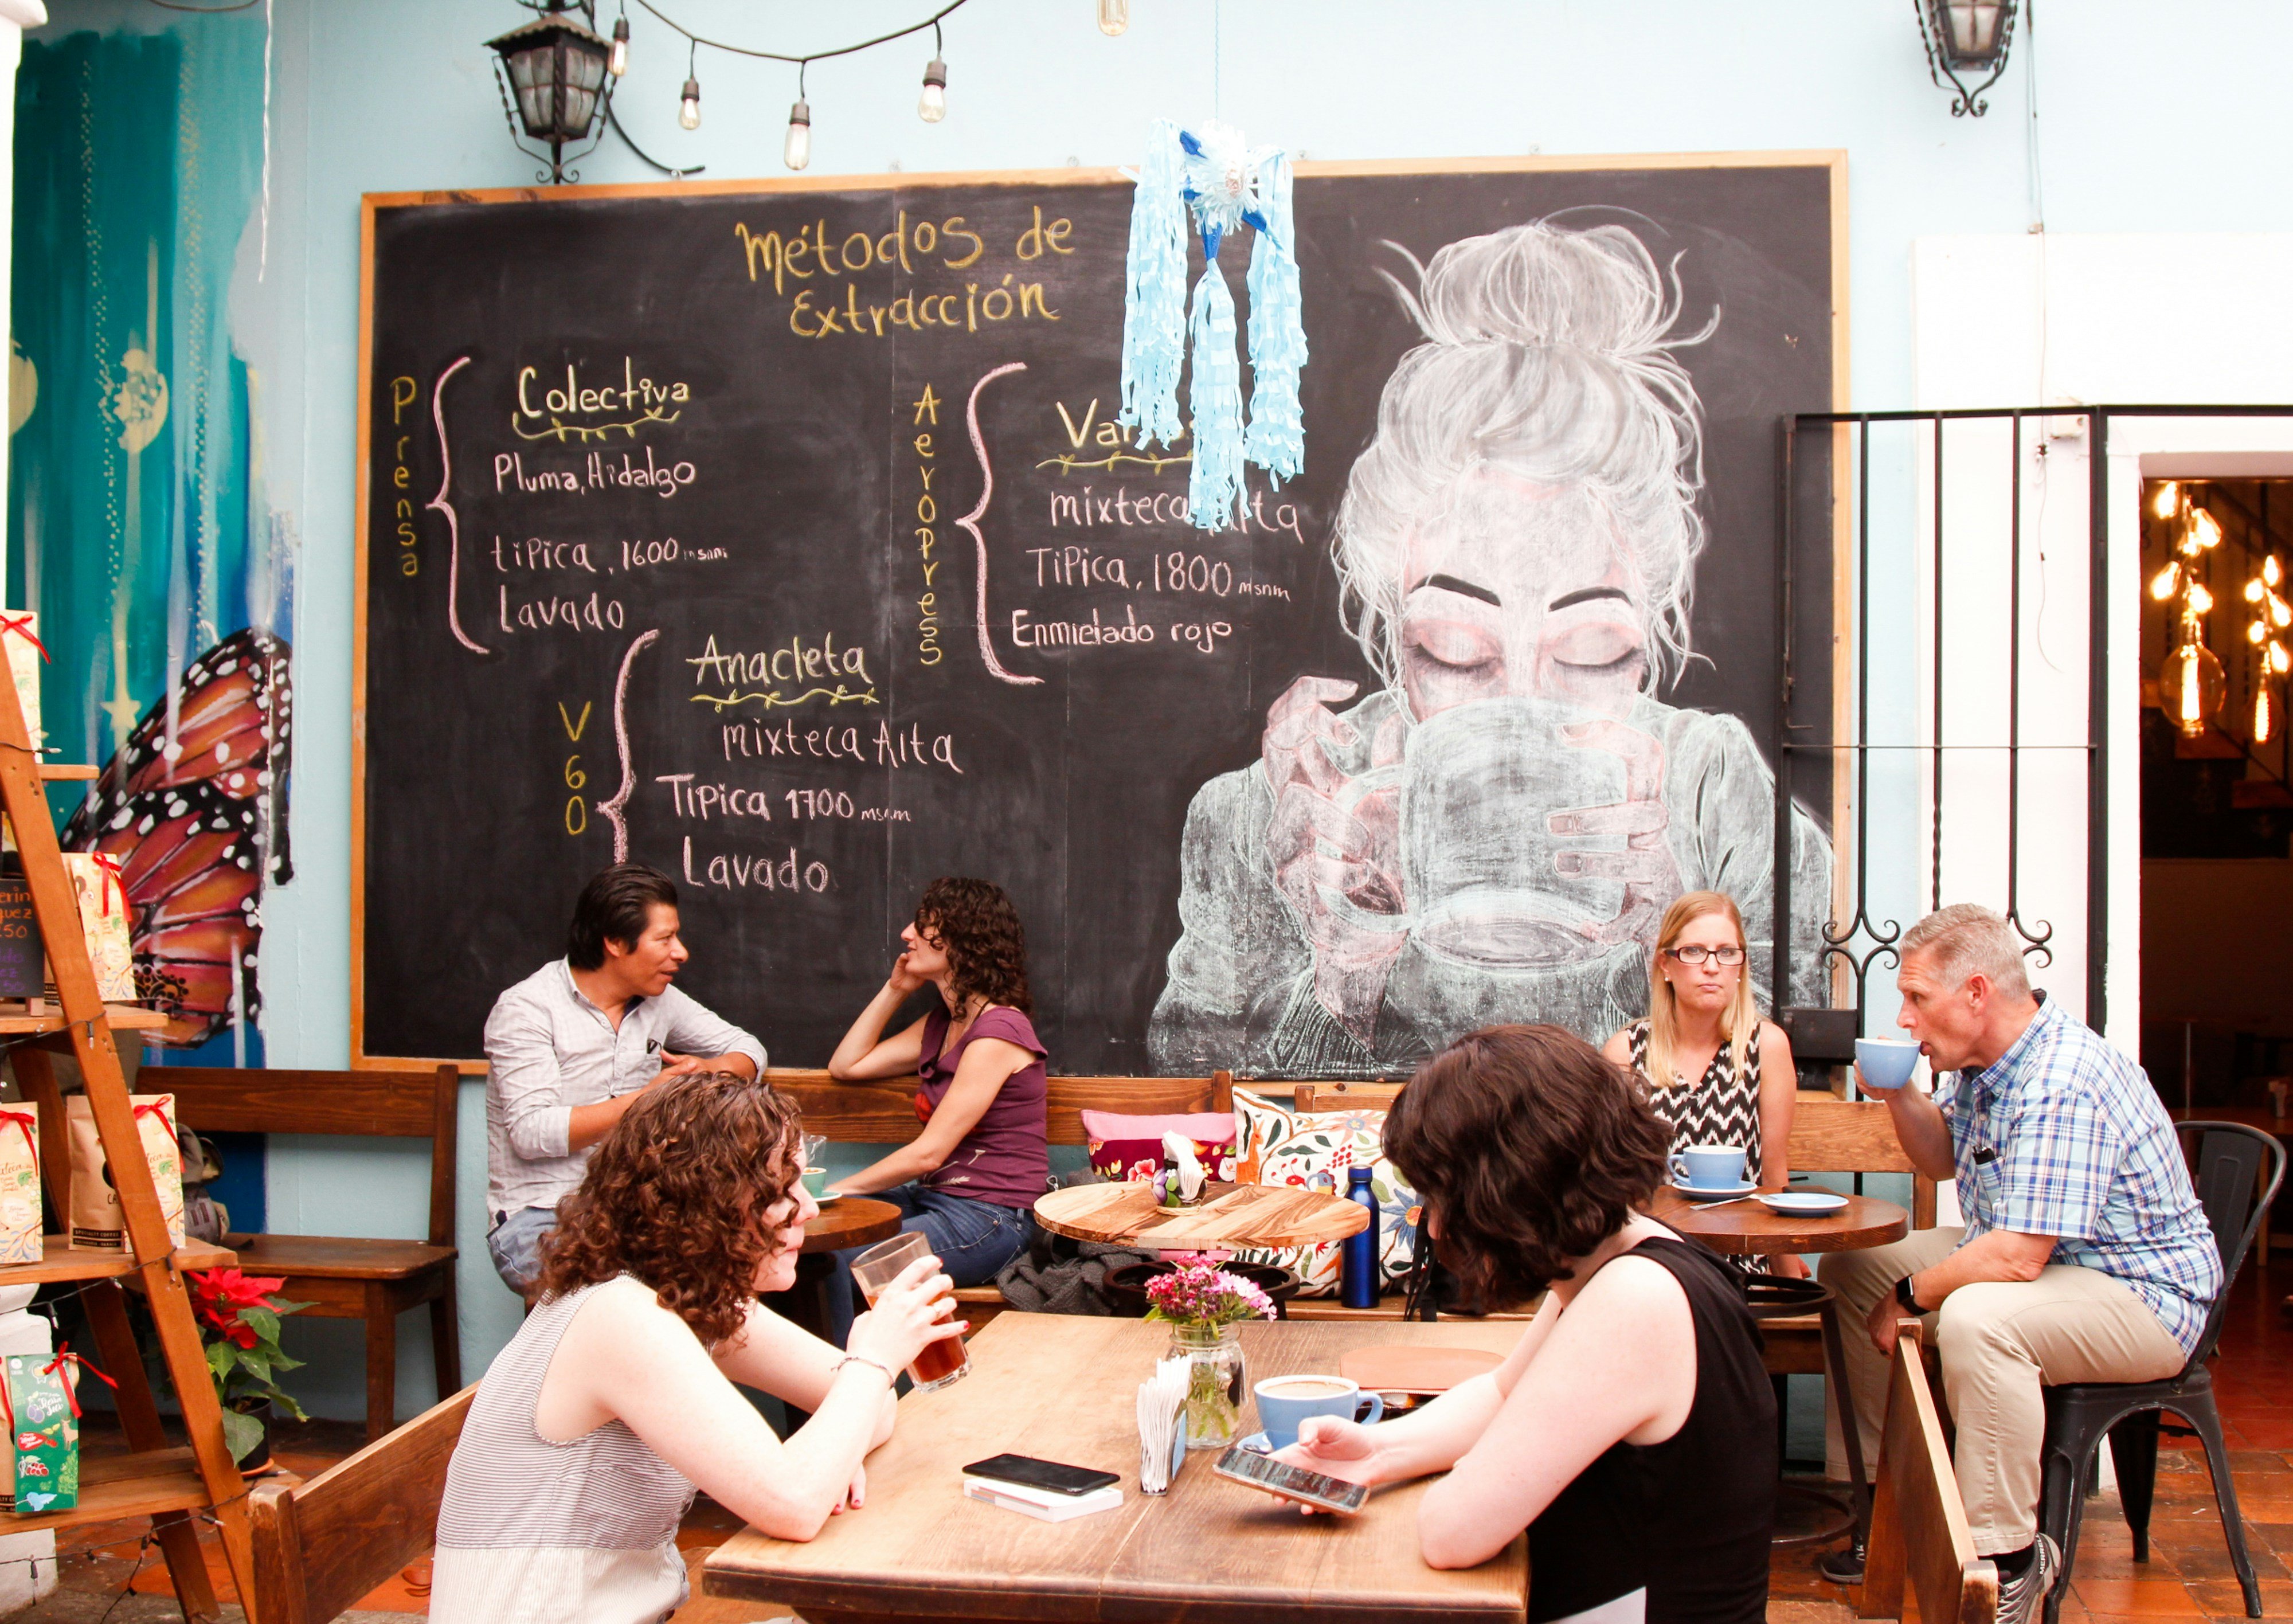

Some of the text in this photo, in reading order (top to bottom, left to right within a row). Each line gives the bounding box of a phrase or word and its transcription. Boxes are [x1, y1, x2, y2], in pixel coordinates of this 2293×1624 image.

[1015, 205, 1075, 261] de
[789, 273, 1061, 338] Extracción
[518, 355, 690, 418] Colectiva
[390, 375, 418, 577] Prensa
[586, 445, 696, 499] Hidalgo
[621, 537, 679, 571] 1600
[1154, 551, 1232, 598] 1800
[1011, 604, 1232, 654] Enmielado rojo
[686, 631, 874, 686] Anacleta
[558, 701, 592, 835] V60
[872, 719, 964, 774] Alta
[784, 788, 855, 820] 1700
[682, 835, 829, 894] Lavado
